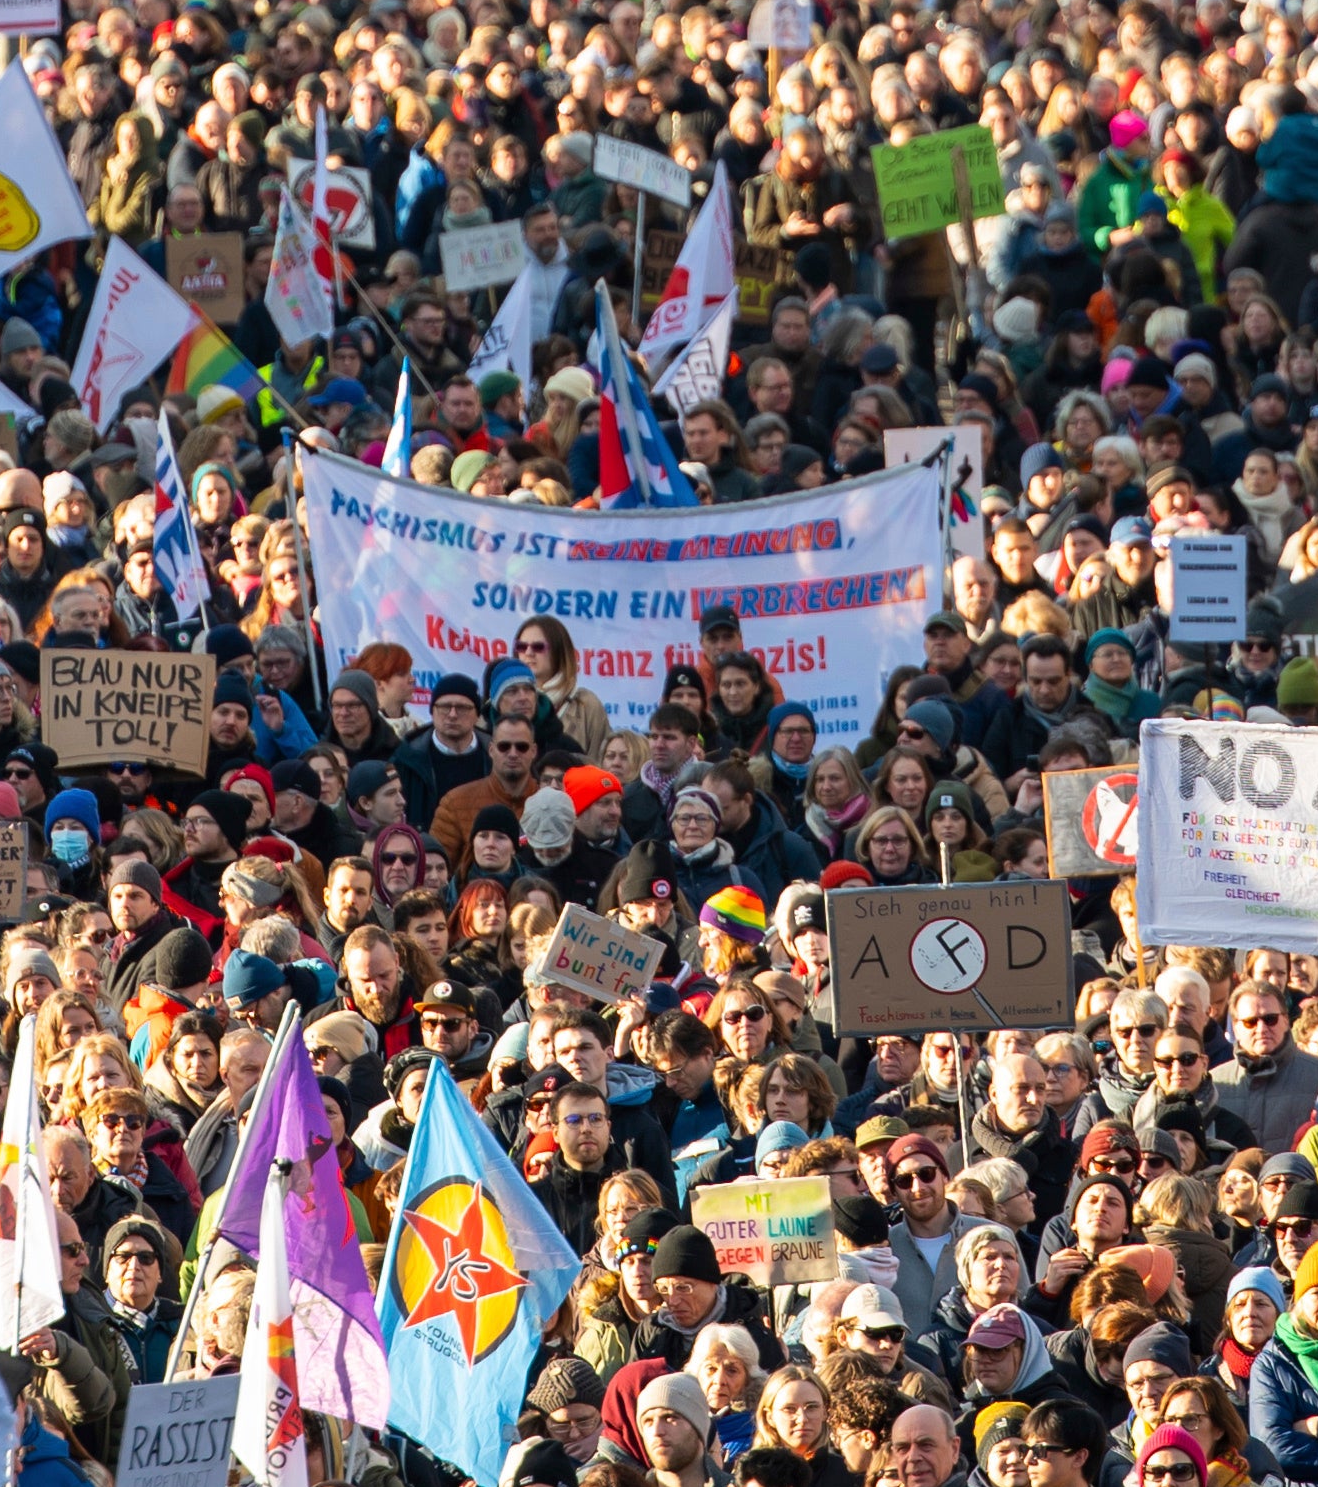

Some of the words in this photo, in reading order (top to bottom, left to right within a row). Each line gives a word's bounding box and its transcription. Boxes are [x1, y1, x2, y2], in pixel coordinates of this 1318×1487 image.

[329, 488, 507, 554] FASCHISMUS
[515, 528, 565, 561] IST
[567, 536, 669, 564] KEINE
[471, 580, 619, 619] SONDERN
[628, 588, 686, 621] EIN
[50, 655, 123, 688] BLAU
[132, 660, 203, 693] NUR
[756, 636, 828, 675] azis!
[52, 691, 82, 720] IN
[94, 689, 204, 726] KNEIPE
[84, 718, 179, 753] TOLL!
[1178, 734, 1298, 809] NO
[1203, 870, 1248, 888] FREIHEIT
[918, 896, 972, 923] genau
[562, 915, 601, 949] Wir
[600, 938, 650, 973] sind
[555, 946, 605, 986] bunt
[744, 1191, 773, 1215] MIT
[704, 1218, 758, 1242] GUTER
[767, 1215, 818, 1239] LAUNE
[770, 1240, 827, 1263] BRAUNE
[424, 1321, 462, 1355] YOUNG
[167, 1386, 208, 1416] DER
[128, 1415, 237, 1472] RASSIST
